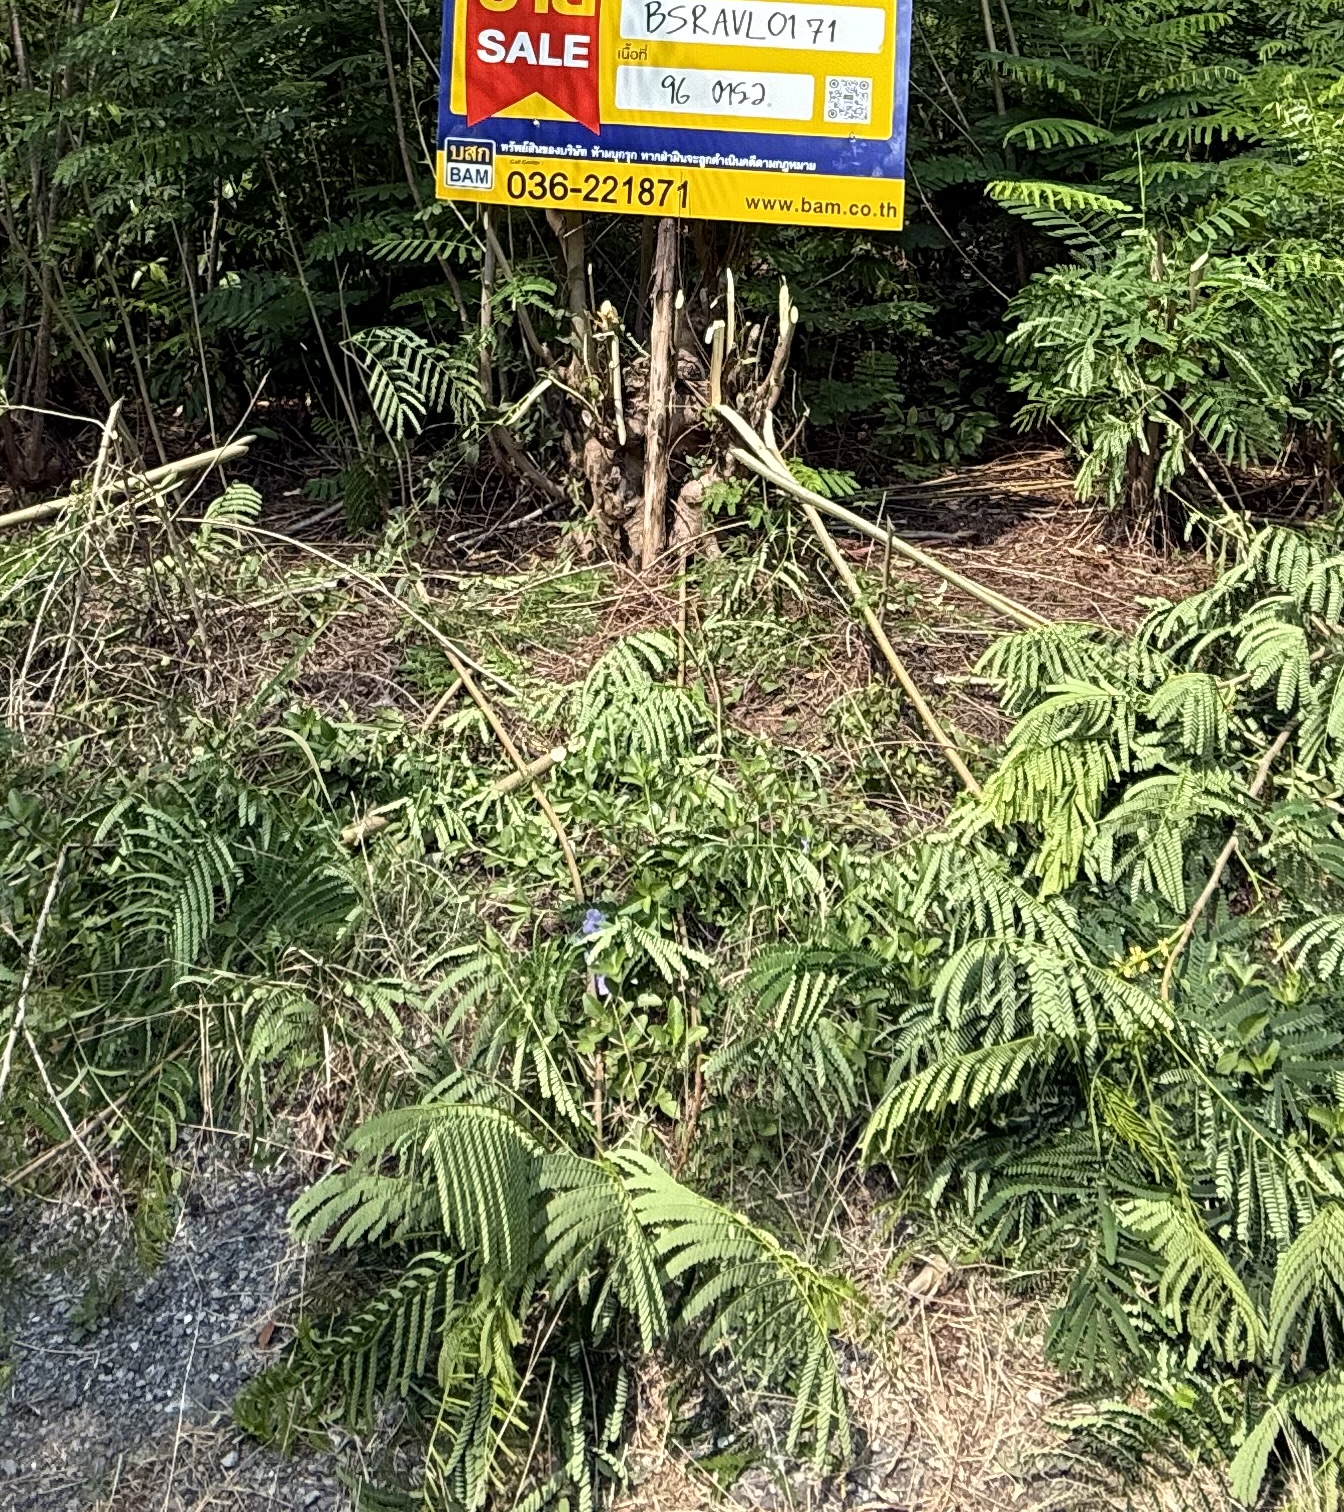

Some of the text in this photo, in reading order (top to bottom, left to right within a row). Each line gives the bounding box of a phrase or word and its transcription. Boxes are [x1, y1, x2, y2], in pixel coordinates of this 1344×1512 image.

[476, 28, 591, 69] SALE
[617, 43, 648, 61] เนื้อที่
[660, 74, 691, 105] 96
[449, 143, 490, 163] บสก
[591, 145, 638, 164] ห้ามบุกรุก
[449, 166, 489, 185] BAM
[507, 170, 689, 209] 036-221871
[745, 196, 898, 218] www.bam.co.th
